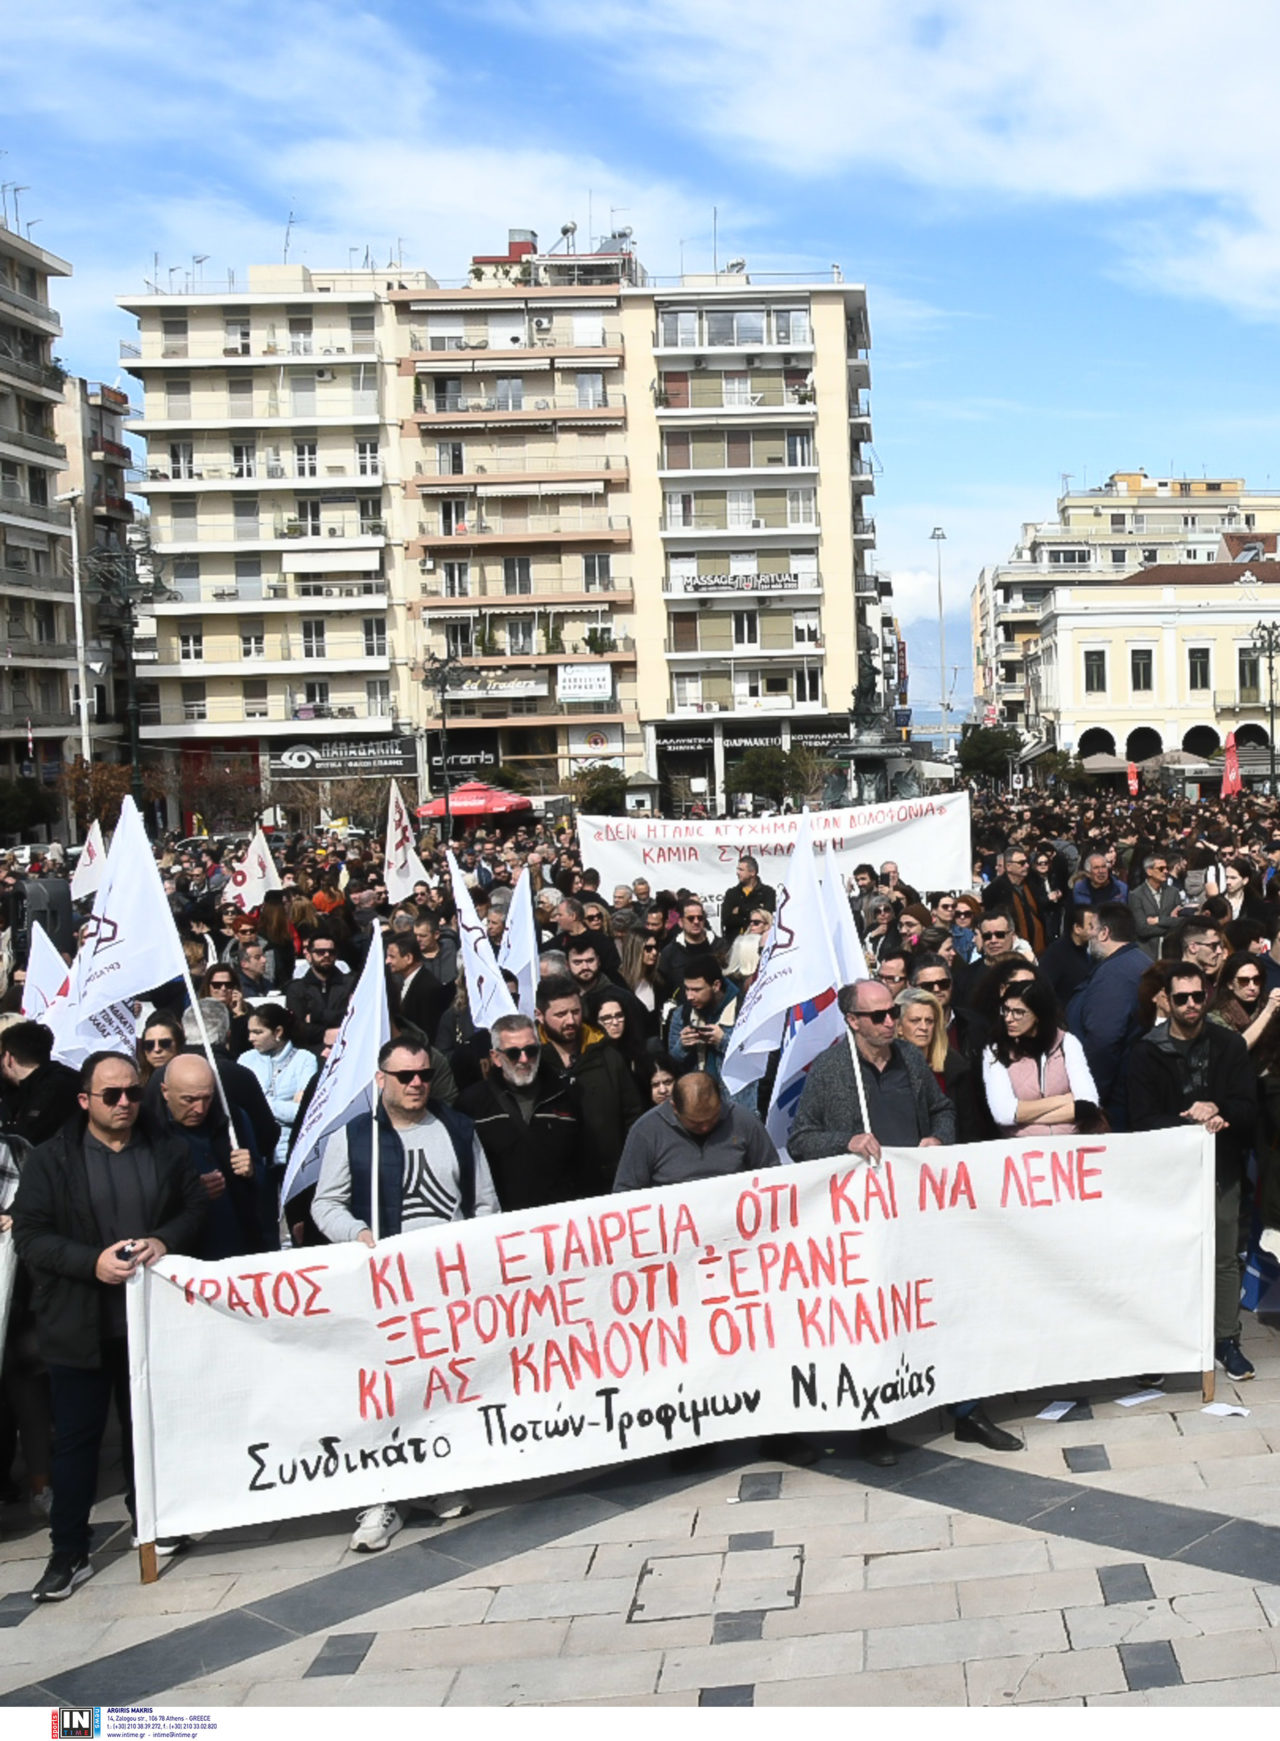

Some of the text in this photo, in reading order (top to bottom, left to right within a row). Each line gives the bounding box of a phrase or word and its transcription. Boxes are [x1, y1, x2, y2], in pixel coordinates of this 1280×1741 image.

[683, 573, 797, 586] MASSAGE RITUAL
[321, 740, 402, 758] ΠΑΠΑΔΑΚΗΣ
[643, 847, 699, 865] ΚΑΜΙΑ
[369, 1251, 414, 1309] ΚΙ
[435, 1241, 467, 1297] Η
[830, 1161, 898, 1225] ΚΑΙ
[919, 1161, 977, 1211] ΝΑ
[1000, 1145, 1107, 1208] ΛΕΝΕ
[358, 1366, 396, 1421] ΚΙ
[424, 1357, 484, 1411] ΑΣ
[510, 1315, 688, 1396] ΚΑΝΟΥΝ
[797, 1278, 937, 1349] ΚΛΑΙΝΕ
[376, 1231, 870, 1366] ΞΕΡΟΥΜΕ ΟΤΙ ΞΕΡΑΝΕ
[248, 1427, 452, 1492] Συνδικάτο
[478, 1384, 760, 1451] Ποτών-Τροφίμων
[791, 1363, 827, 1411] Ν.
